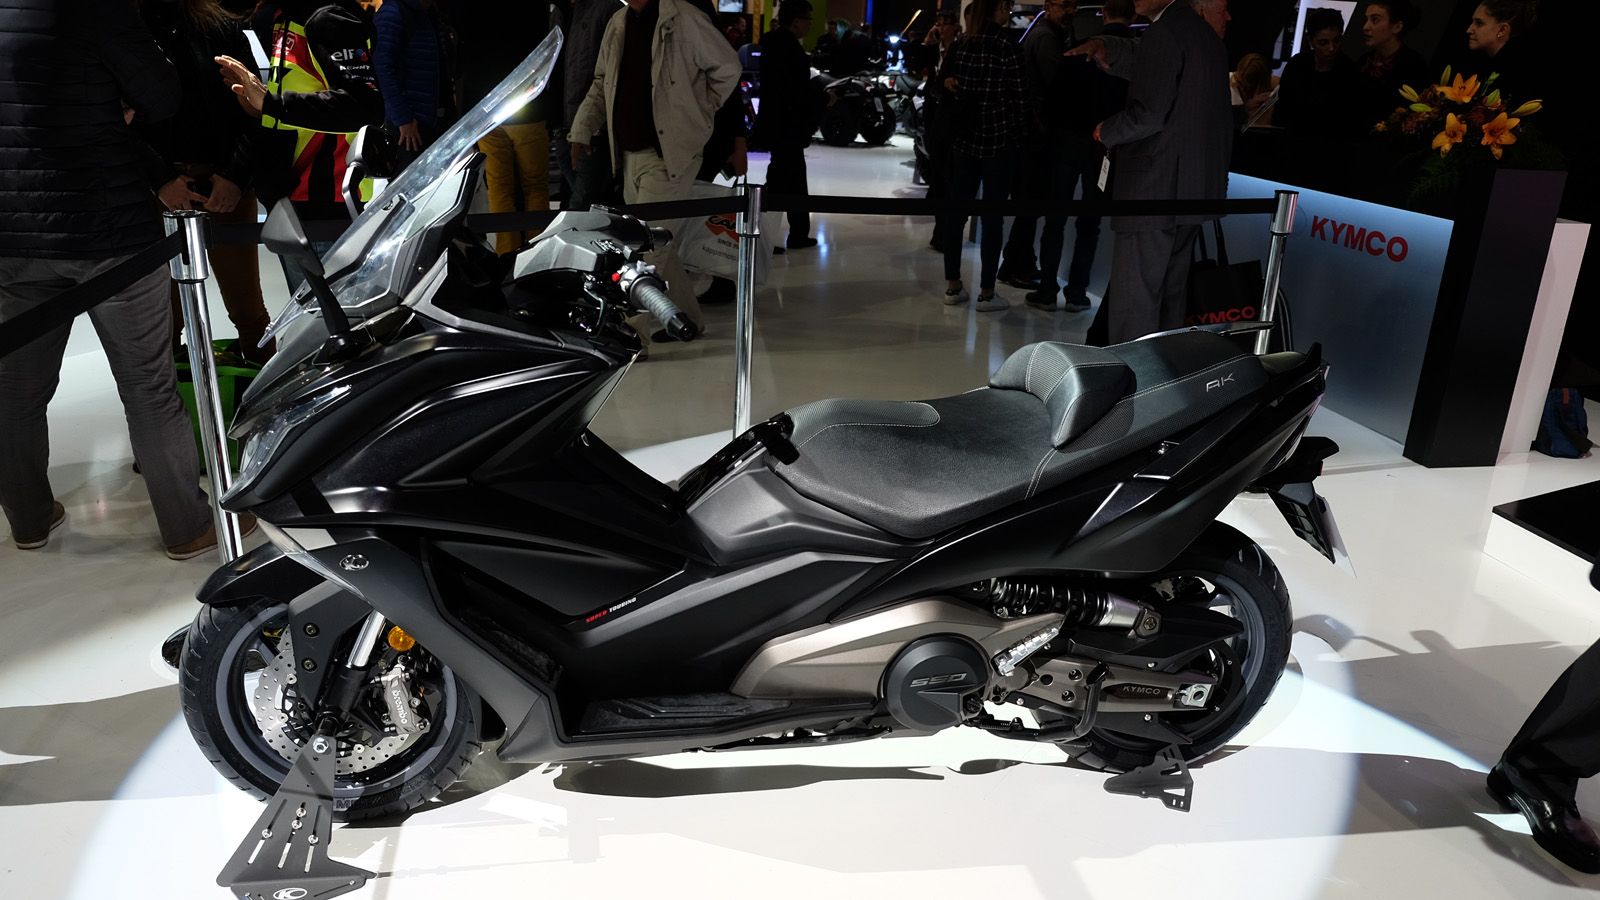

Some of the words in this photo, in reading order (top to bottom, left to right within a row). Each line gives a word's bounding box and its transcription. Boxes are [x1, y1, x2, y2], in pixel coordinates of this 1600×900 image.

[1311, 215, 1409, 263] KYMCO
[1206, 373, 1235, 392] AK
[609, 597, 637, 613] TOURING
[1123, 685, 1161, 695] KYMCO
[392, 689, 408, 724] brembo
